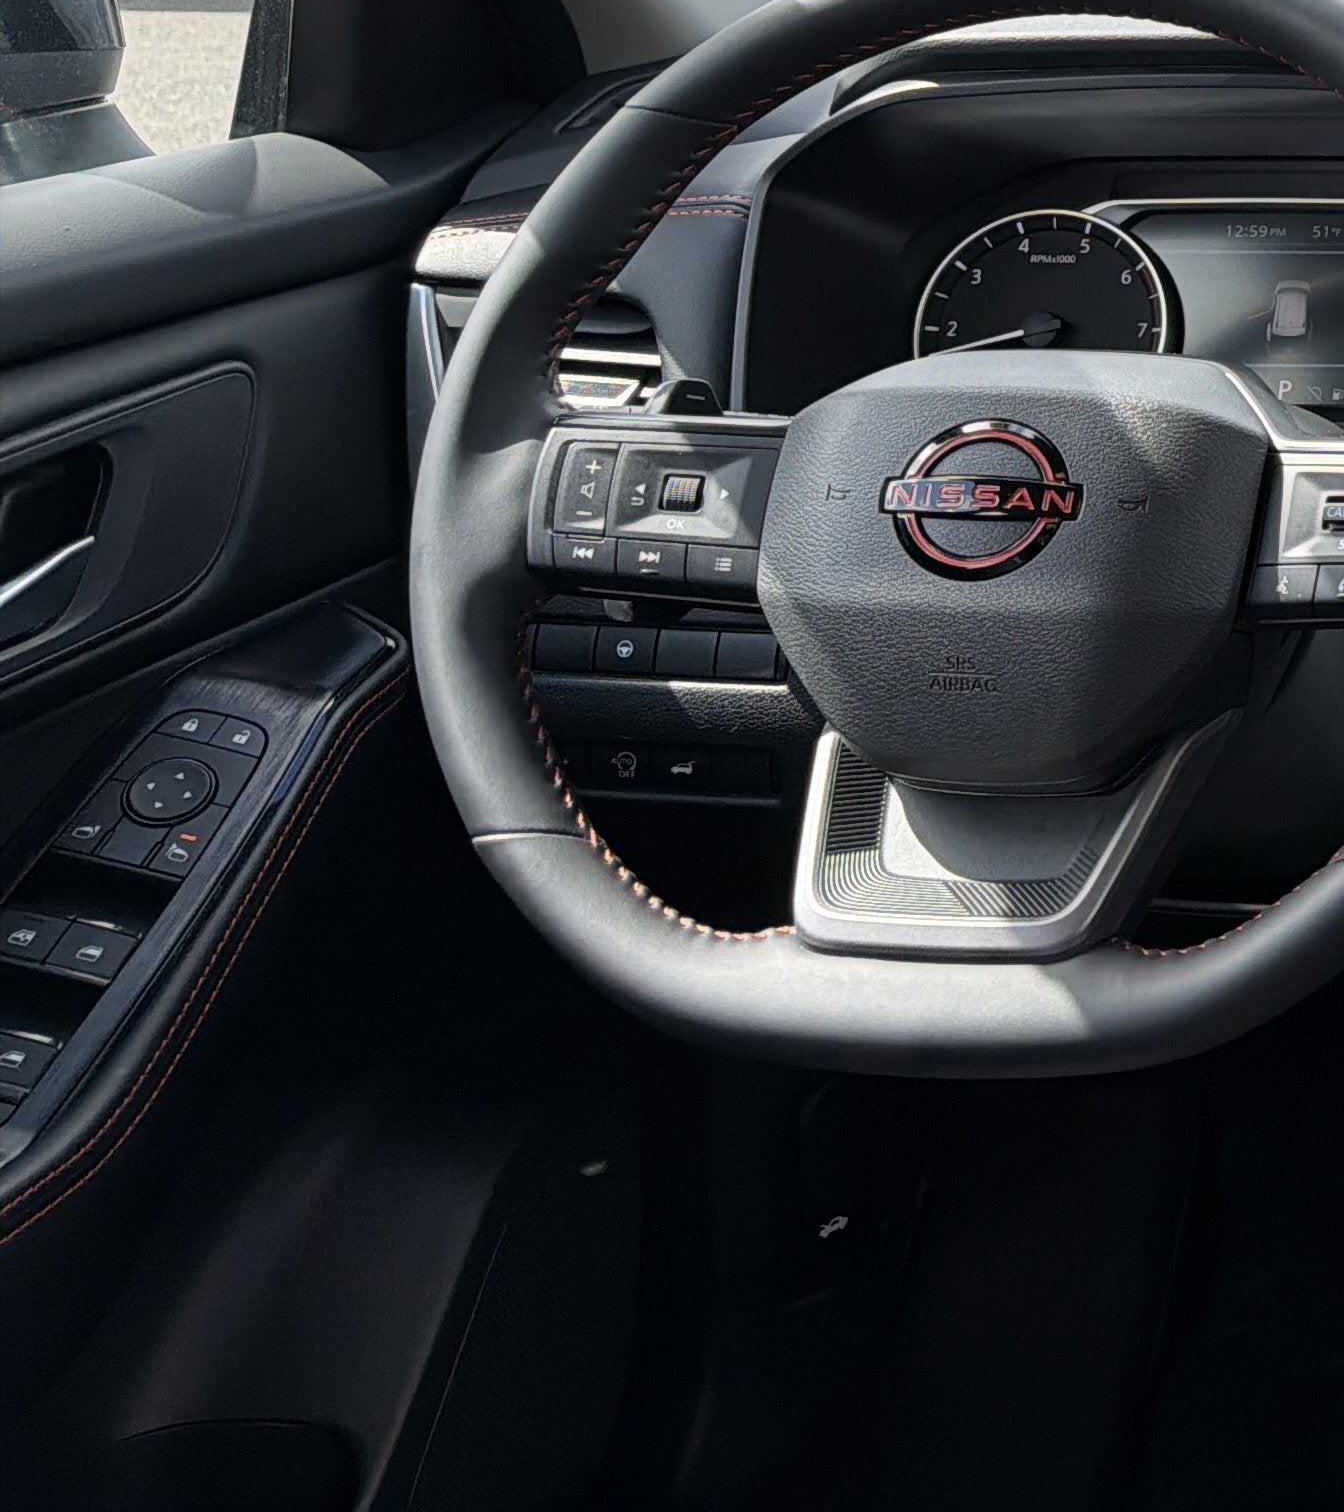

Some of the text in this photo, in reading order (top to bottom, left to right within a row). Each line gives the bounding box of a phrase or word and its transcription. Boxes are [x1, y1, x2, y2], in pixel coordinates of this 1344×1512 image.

[1018, 238, 1030, 254] 4
[1079, 238, 1091, 255] 5
[971, 269, 982, 285] 3
[1121, 269, 1133, 285] 6
[946, 321, 958, 337] 2
[1137, 322, 1148, 338] 7
[1278, 379, 1292, 401] P
[888, 481, 1075, 515] NISSAN
[665, 518, 685, 530] OK
[945, 655, 977, 670] SRS
[928, 676, 1001, 693] AIRBAG
[618, 769, 636, 779] OFF
